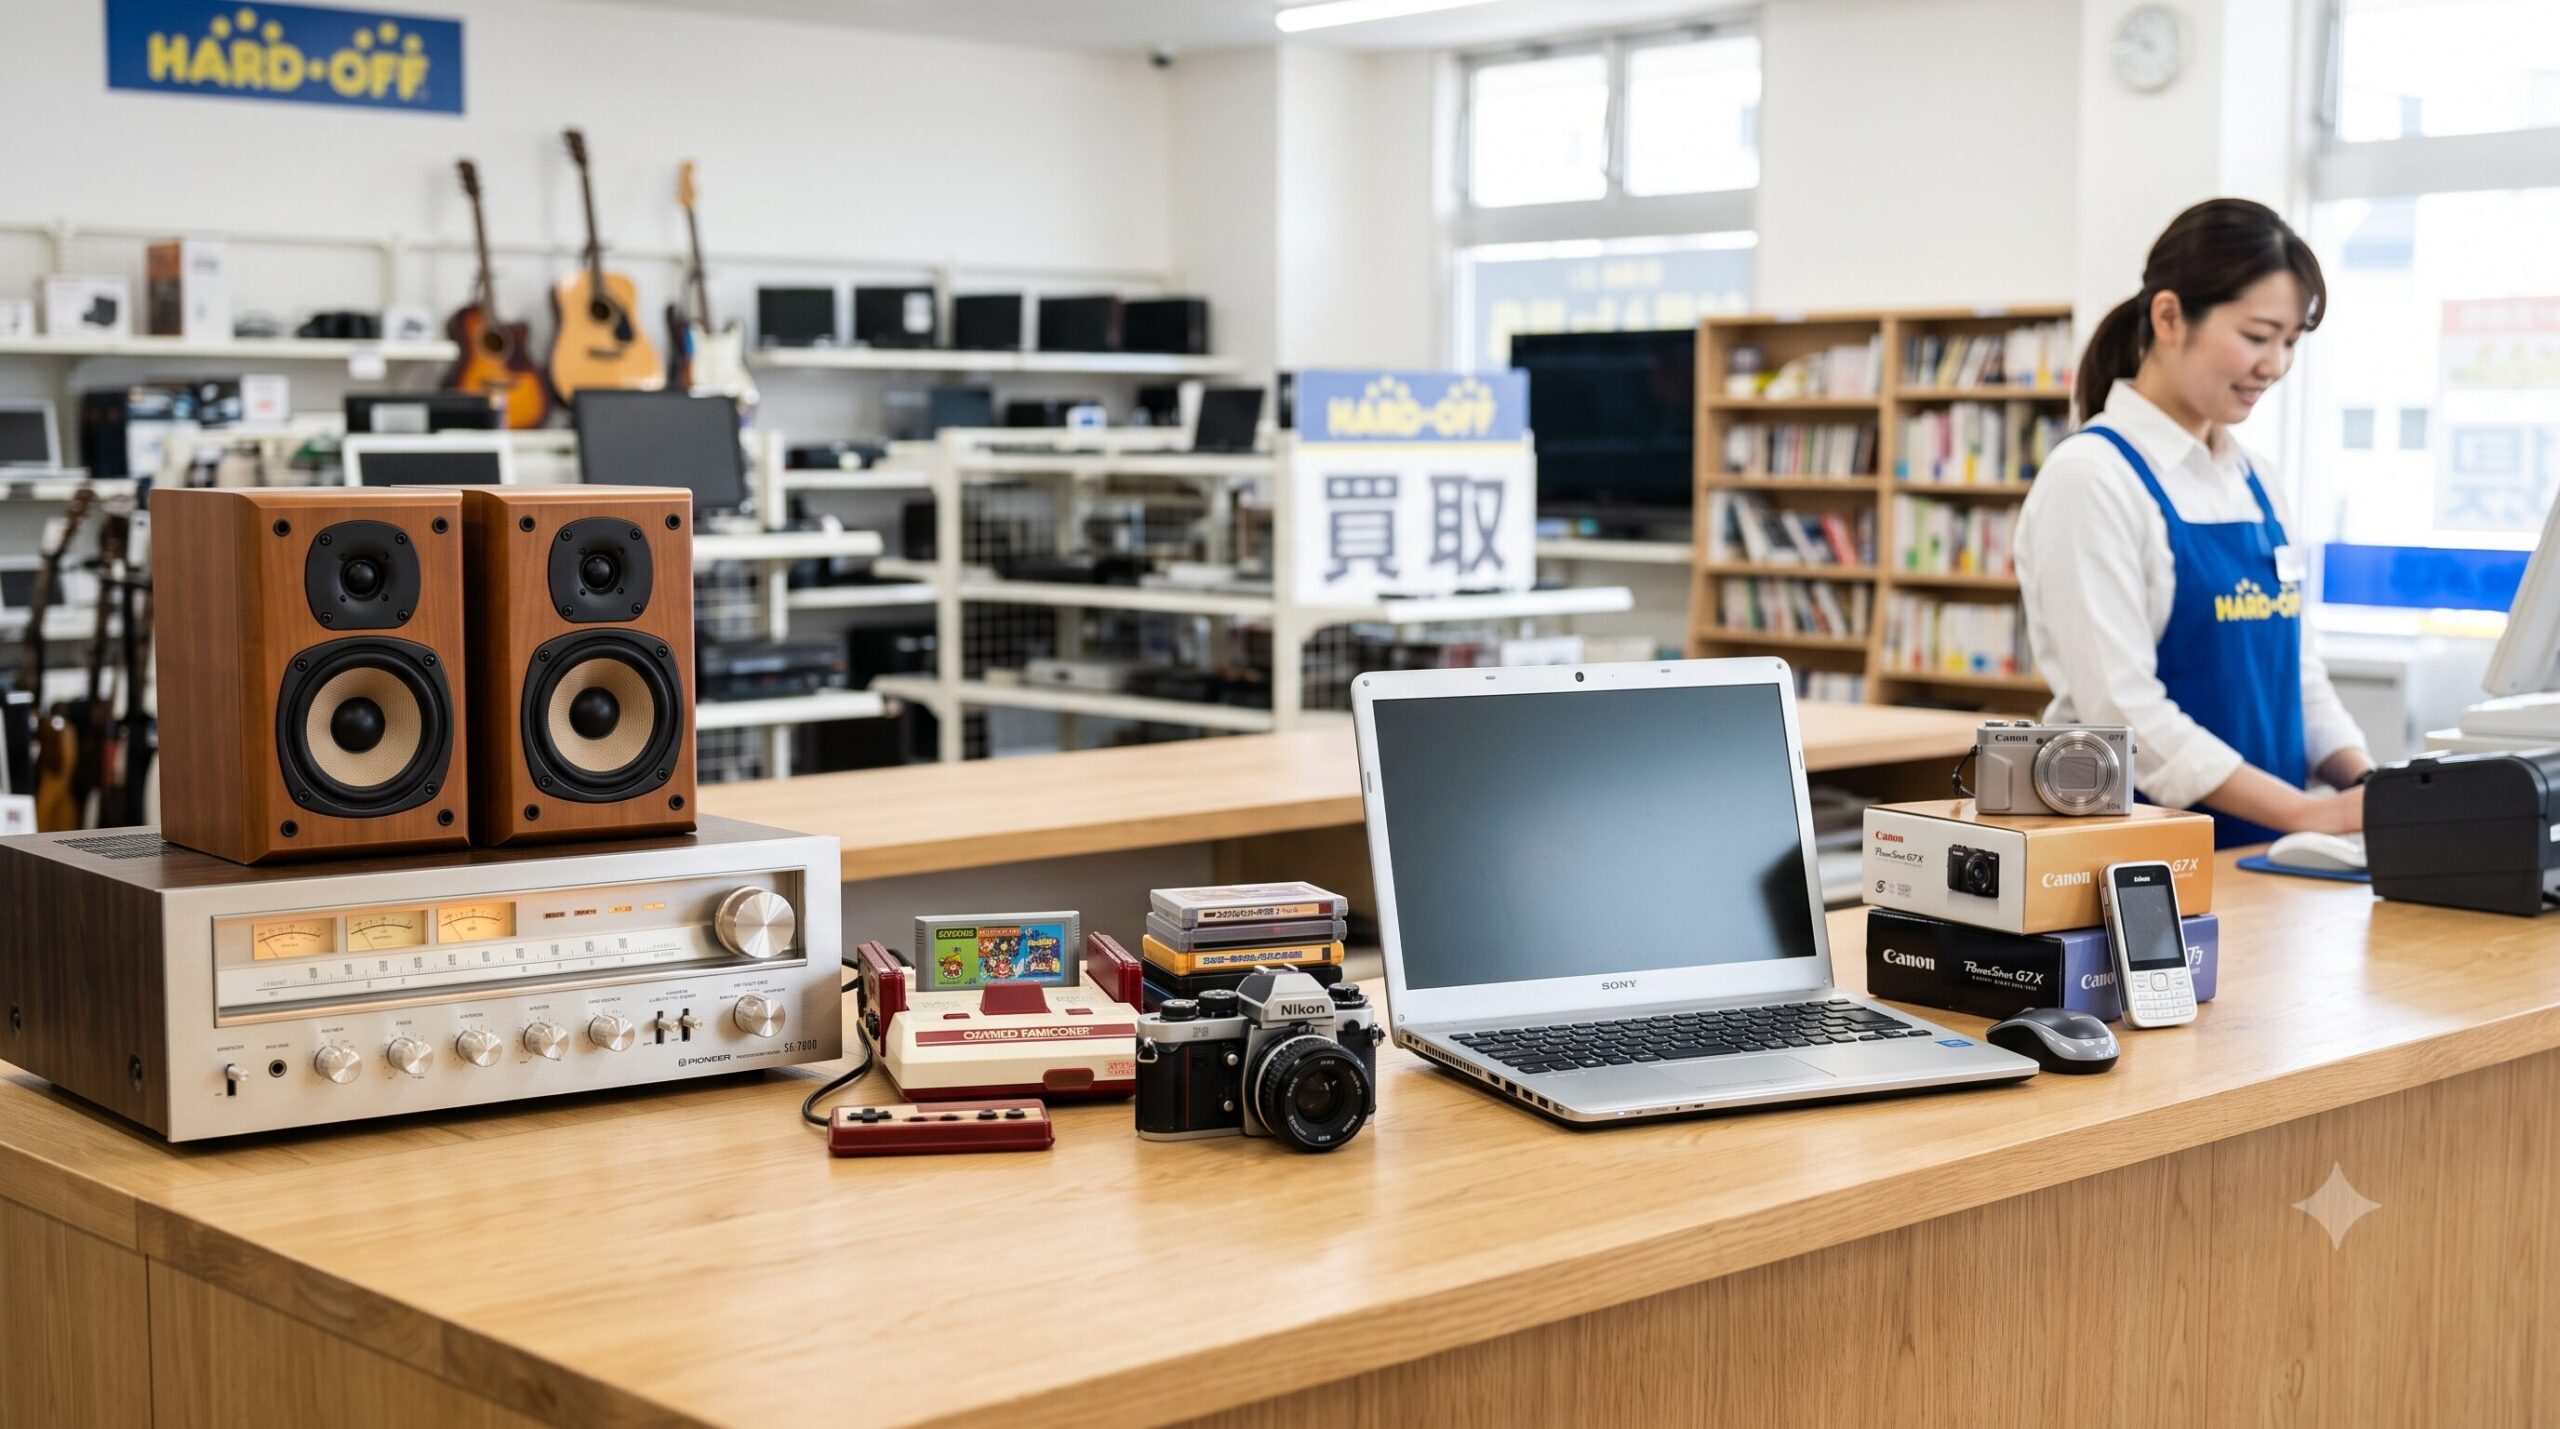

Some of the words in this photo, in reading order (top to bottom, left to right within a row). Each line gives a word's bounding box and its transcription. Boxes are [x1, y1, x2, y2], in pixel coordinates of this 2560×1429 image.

[1325, 475, 1504, 582] 買取
[1995, 734, 2028, 742] Canon
[1875, 831, 1904, 843] Canon
[2042, 871, 2091, 888] Canon
[1883, 949, 1935, 971] Canon
[1602, 980, 1637, 990] SONY
[2081, 972, 2114, 989] Cano
[1281, 1003, 1325, 1016] Nikon
[688, 1053, 731, 1065] PIONEER
